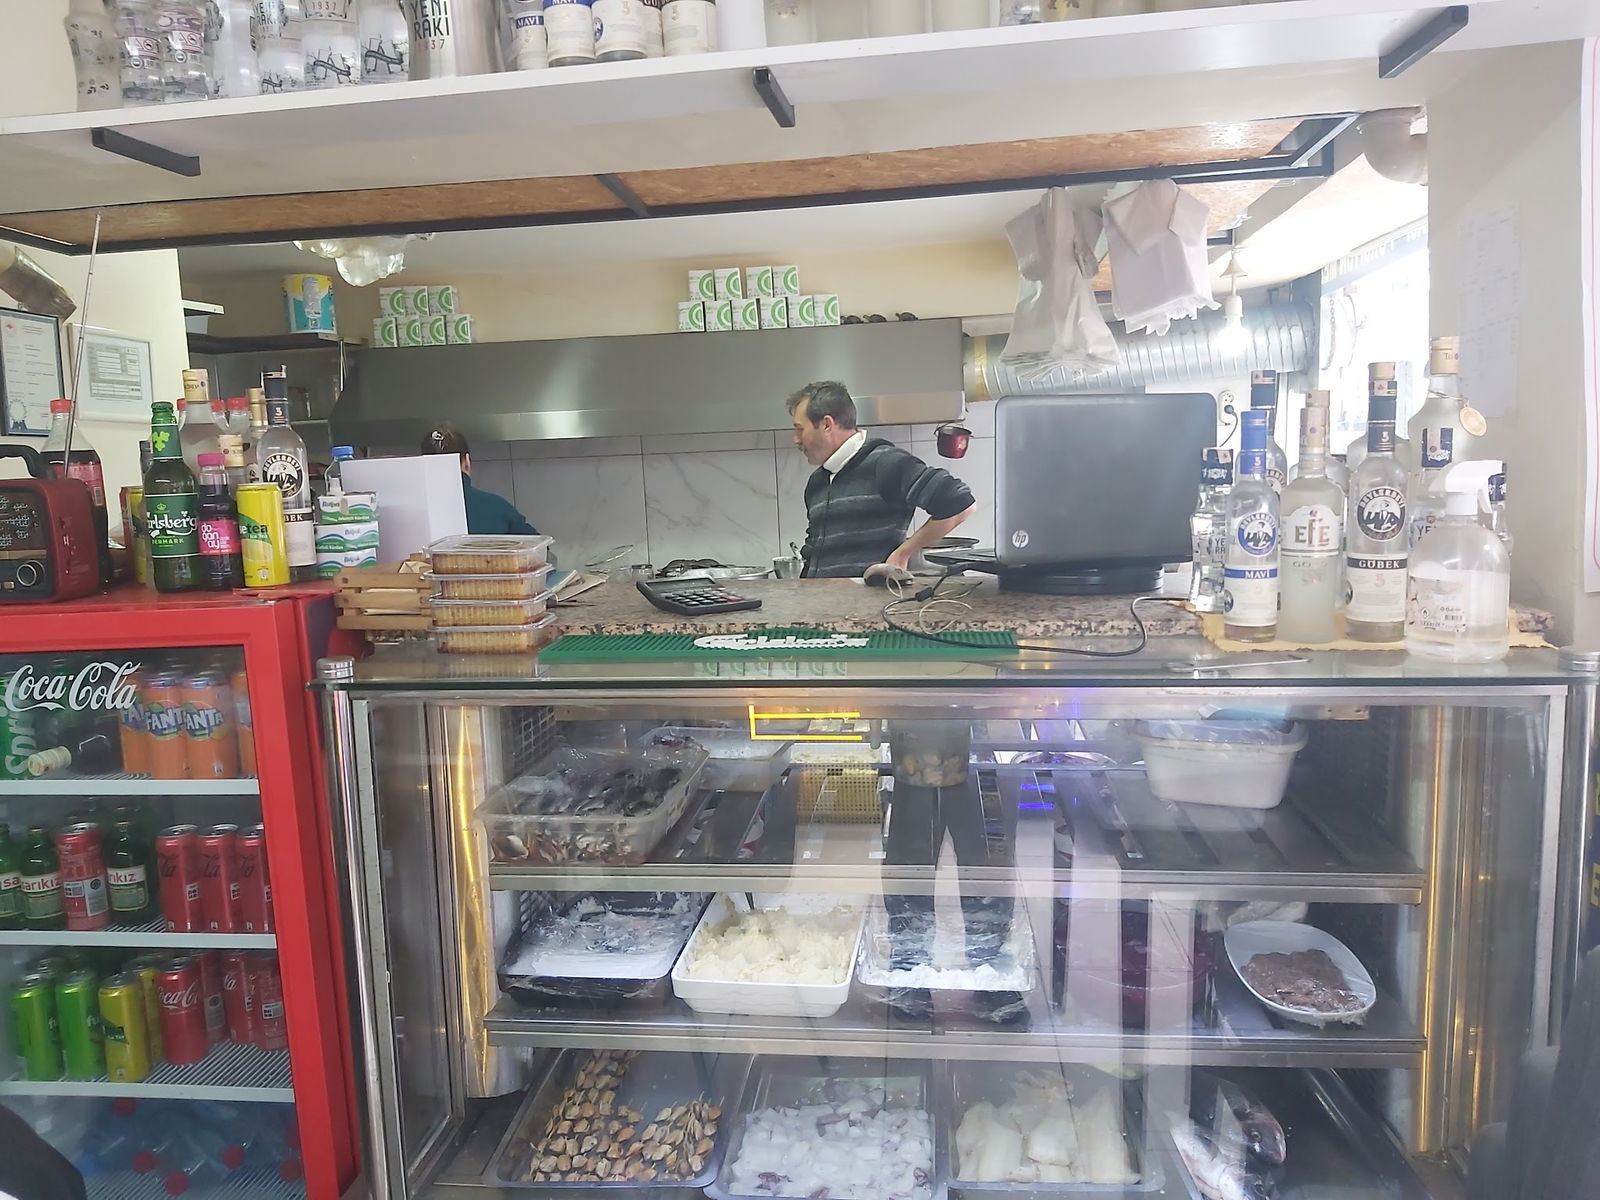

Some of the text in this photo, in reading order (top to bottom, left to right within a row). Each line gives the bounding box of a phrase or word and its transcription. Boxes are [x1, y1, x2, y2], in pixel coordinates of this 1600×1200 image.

[414, 17, 450, 40] RAKI
[284, 514, 304, 522] BEK
[1358, 559, 1400, 569] GÖBEK
[4, 661, 142, 712] Coca-Cola
[183, 708, 224, 731] ANTA
